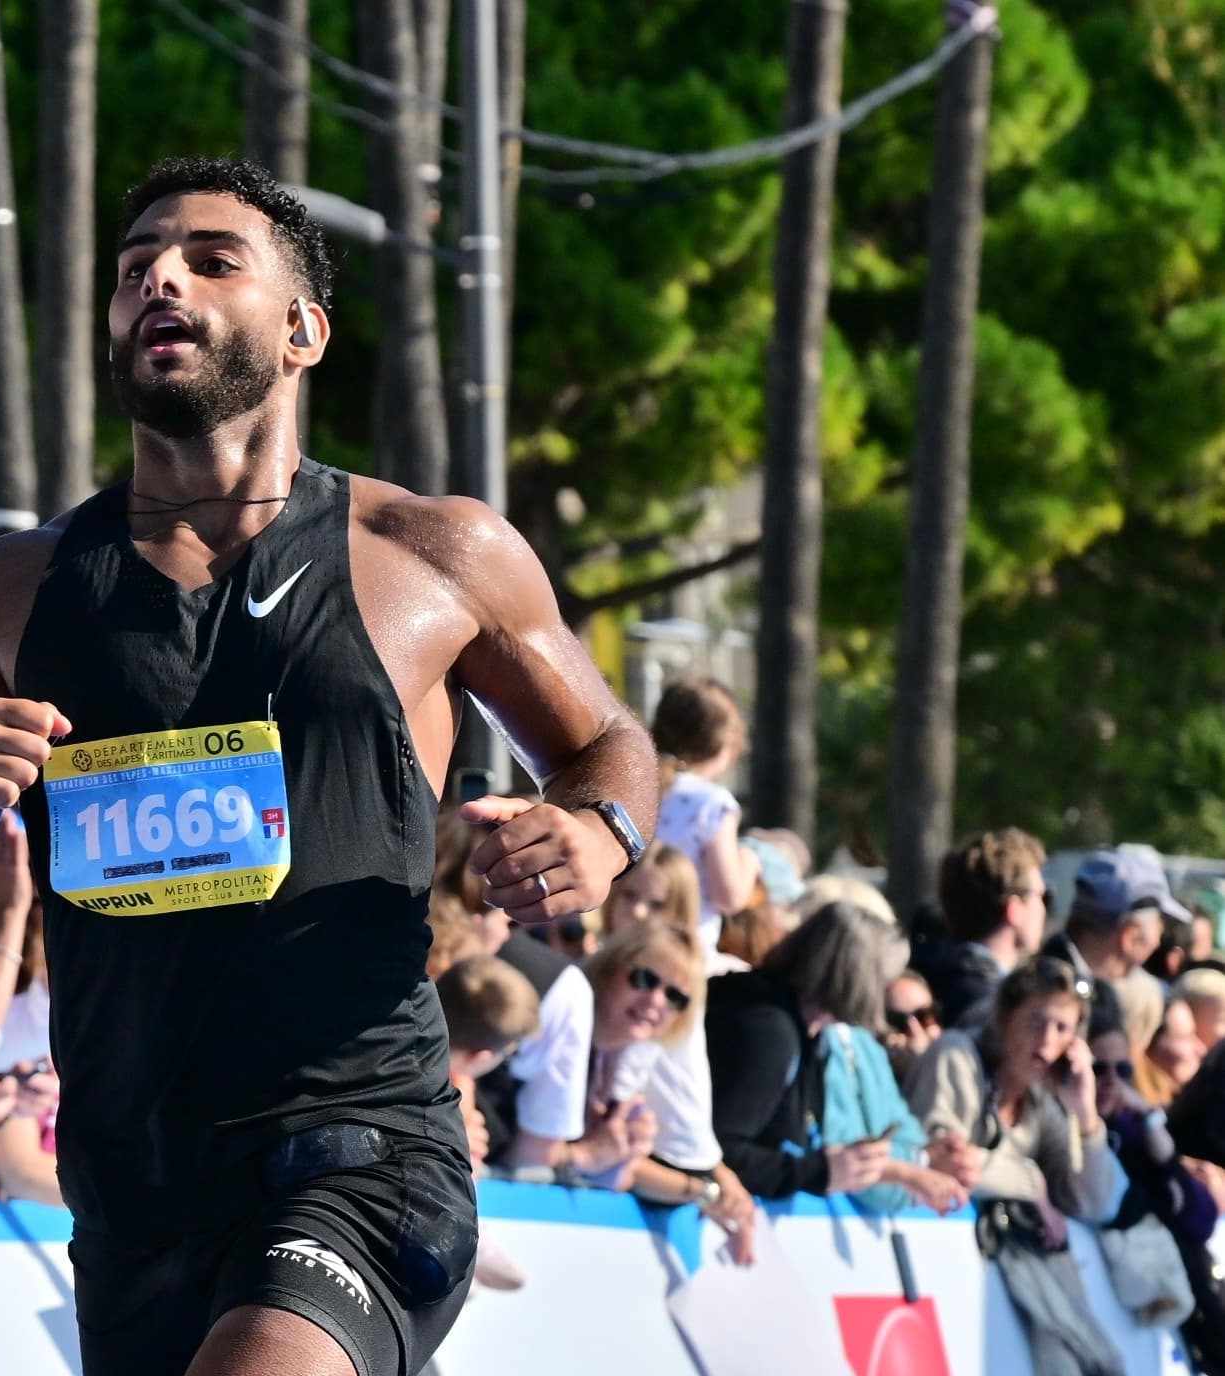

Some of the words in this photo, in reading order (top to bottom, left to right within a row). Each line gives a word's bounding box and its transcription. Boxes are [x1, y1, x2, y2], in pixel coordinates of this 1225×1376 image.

[93, 736, 194, 758] DÉPARTEMENT
[204, 729, 245, 755] 06
[96, 759, 113, 768] DES
[50, 775, 99, 792] MARATHON
[76, 785, 254, 861] 11669
[164, 873, 274, 897] METROPOLITAN
[170, 895, 202, 906] SPORT
[208, 891, 232, 902] CLUB
[251, 887, 268, 897] SPA
[266, 1250, 316, 1268] NIKE
[325, 1268, 370, 1315] TRAIL
